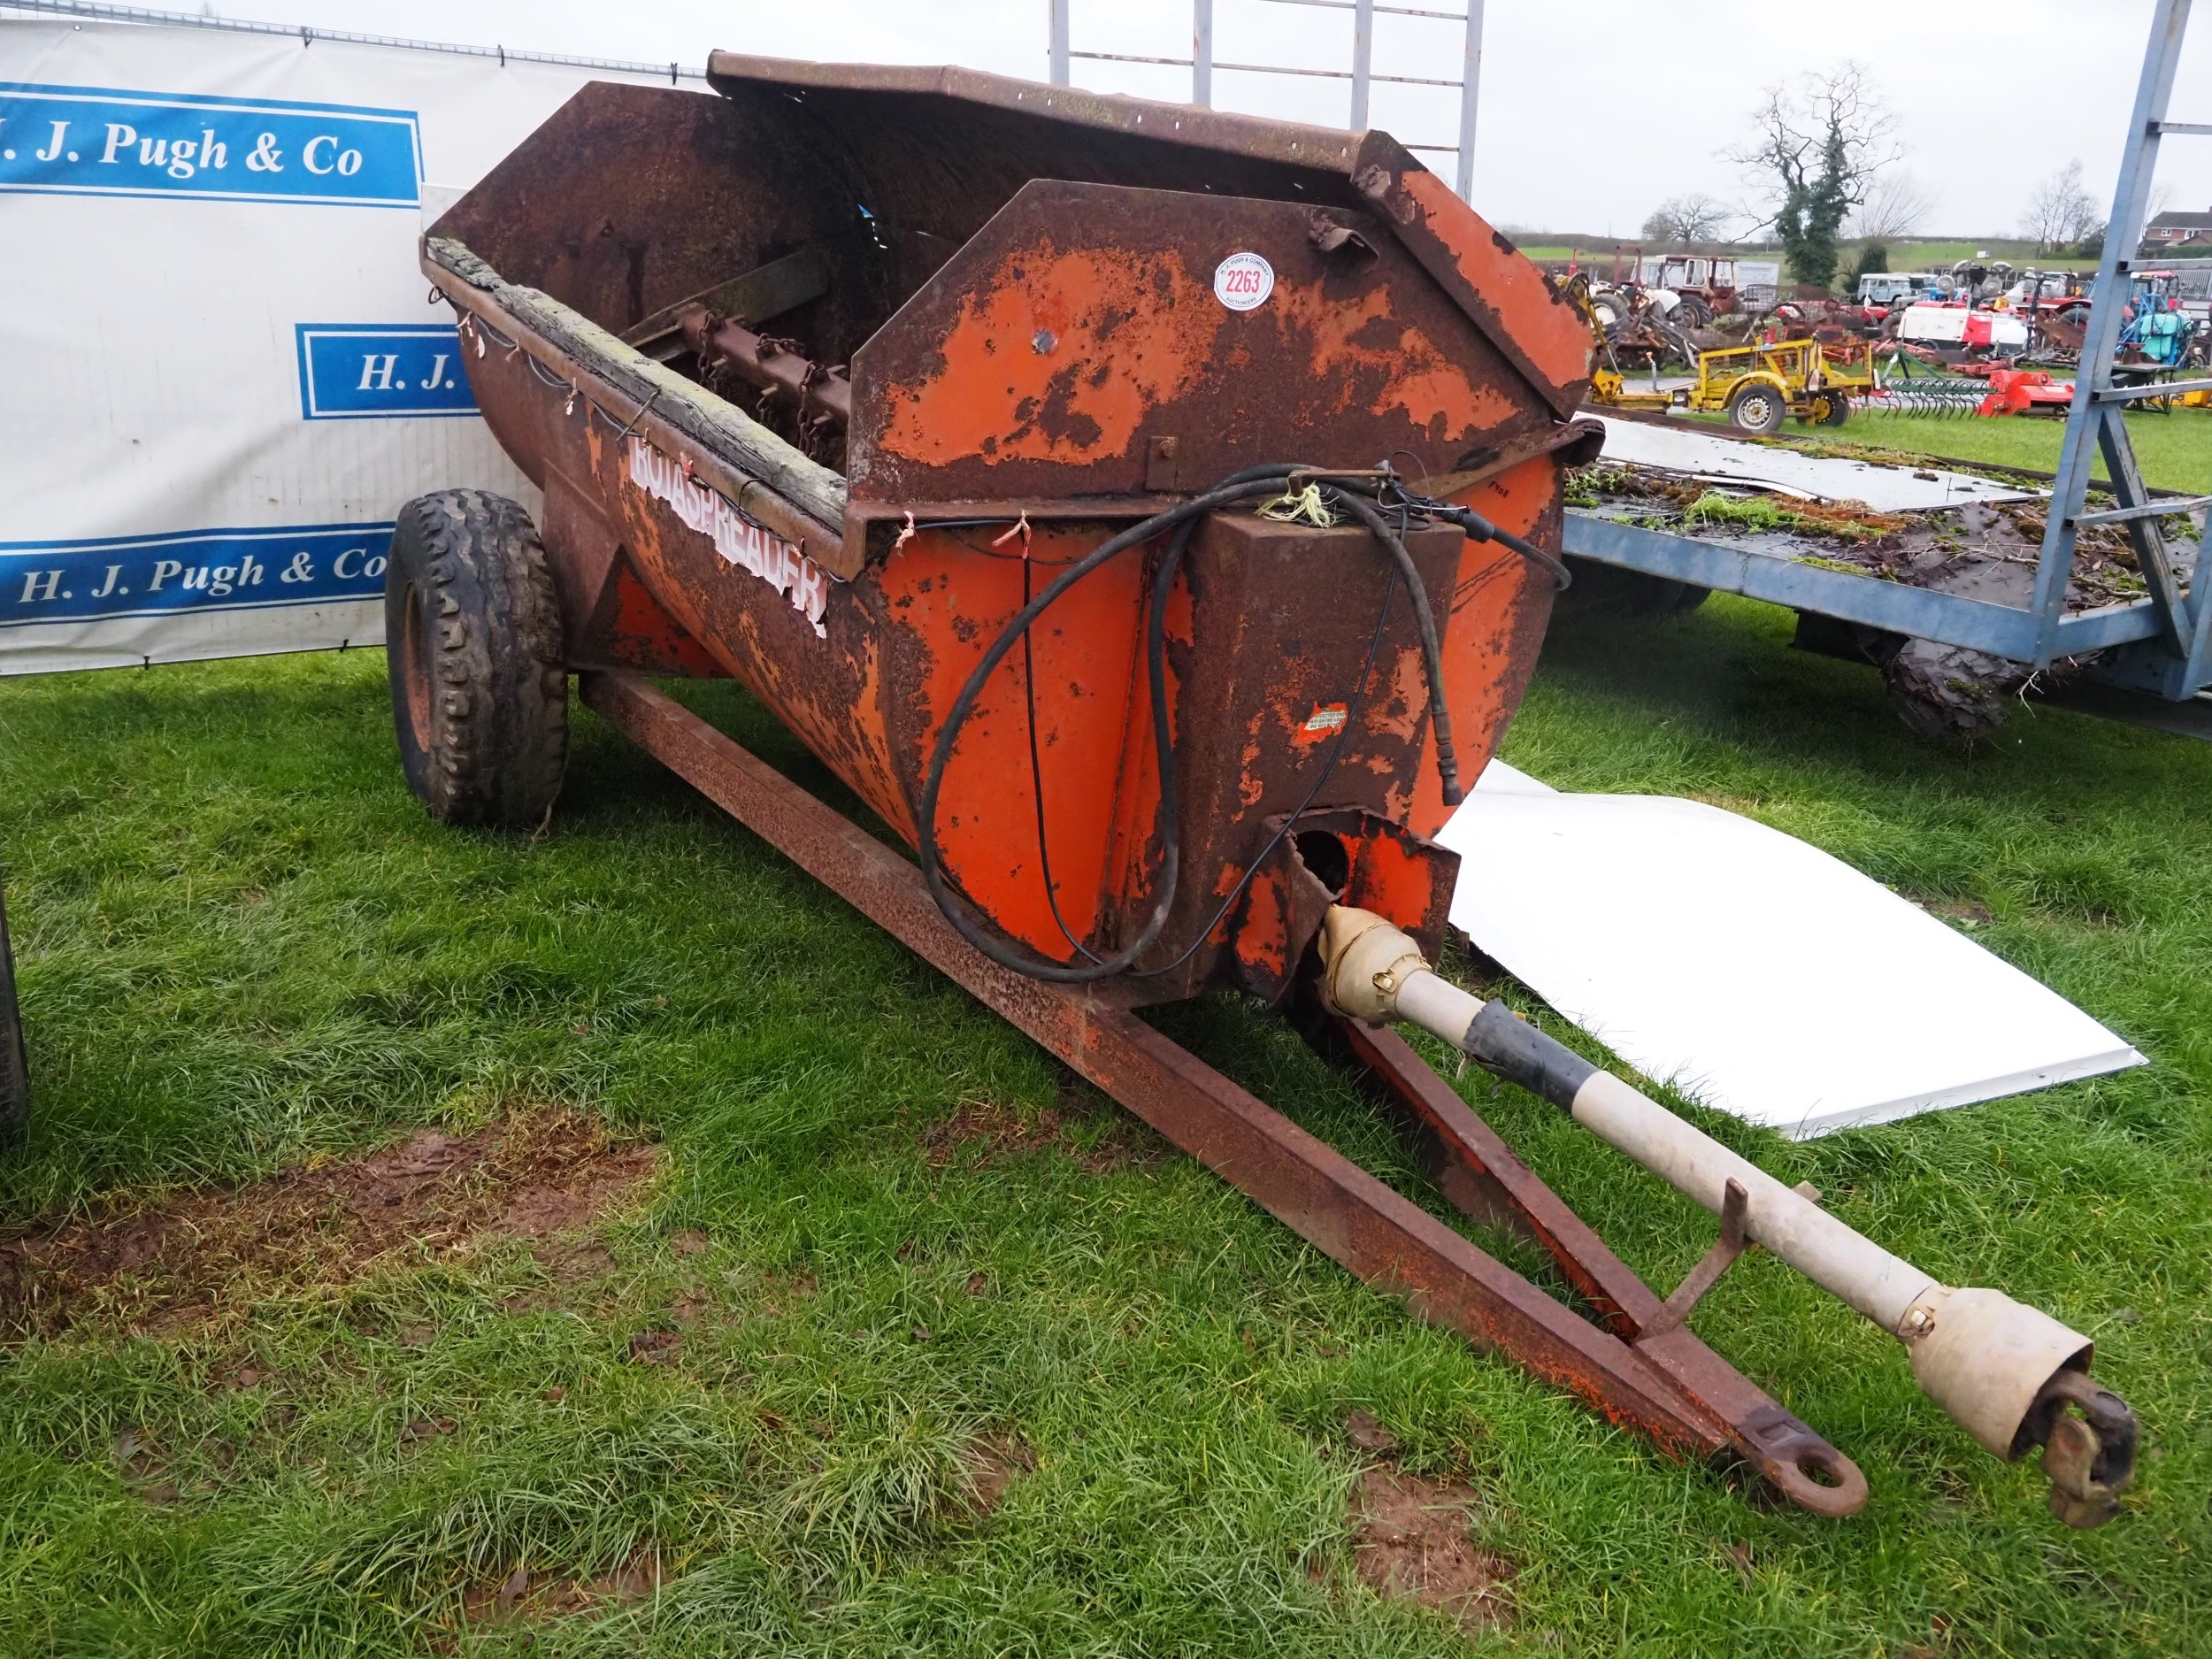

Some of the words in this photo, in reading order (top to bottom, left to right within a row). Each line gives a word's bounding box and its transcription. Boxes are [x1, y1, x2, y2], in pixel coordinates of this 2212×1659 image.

[36, 120, 80, 163] J.
[97, 123, 228, 179] Pugh
[245, 132, 285, 173] &
[303, 135, 363, 176] Co
[1225, 269, 1261, 294] 2263
[1249, 258, 1269, 276] COMPANY
[356, 354, 406, 390] H.
[420, 354, 455, 390] J.
[17, 569, 73, 603] H.
[90, 565, 129, 599] J.
[147, 555, 265, 596] Pugh
[280, 551, 316, 583] &
[333, 548, 388, 580] Co
